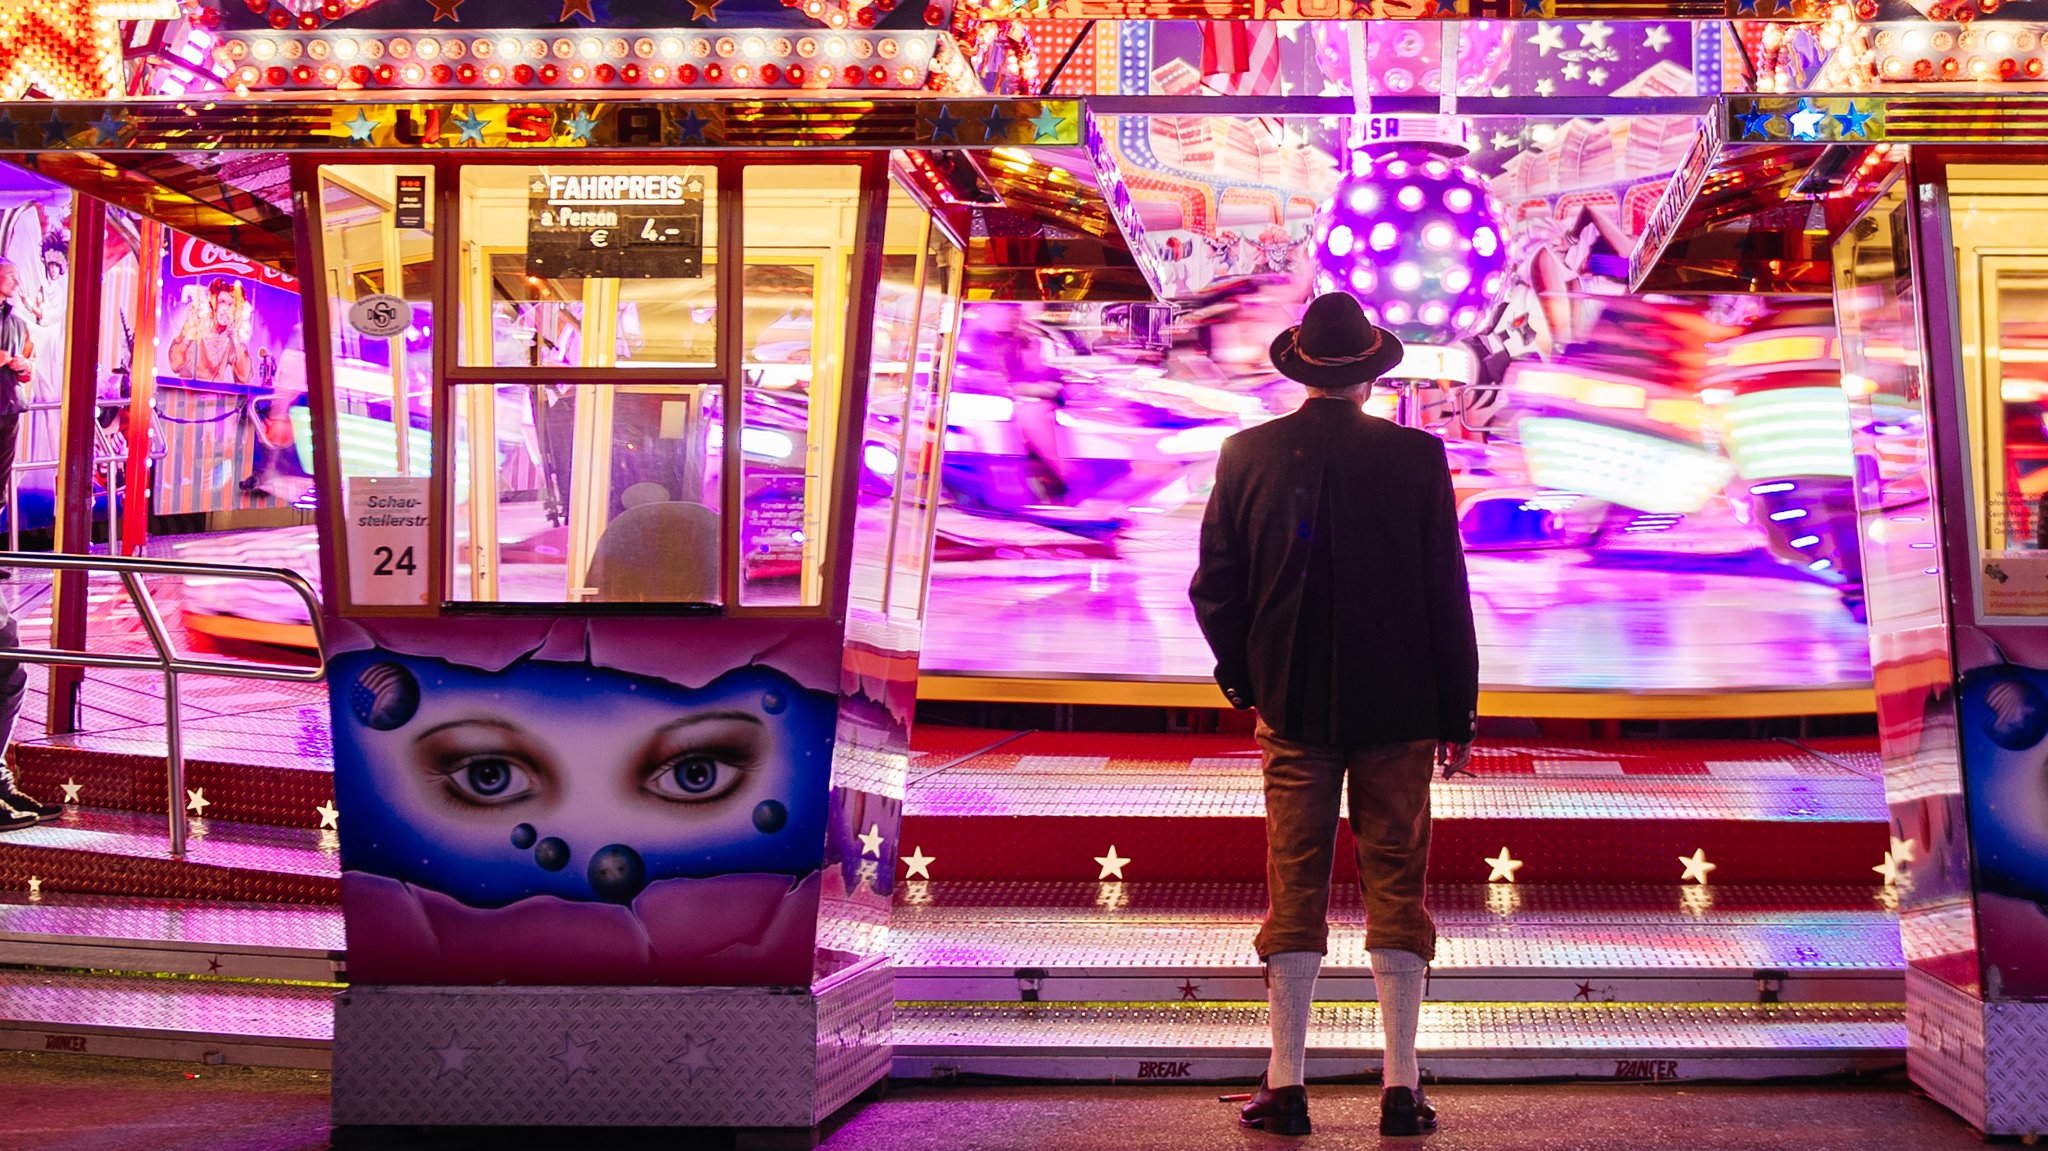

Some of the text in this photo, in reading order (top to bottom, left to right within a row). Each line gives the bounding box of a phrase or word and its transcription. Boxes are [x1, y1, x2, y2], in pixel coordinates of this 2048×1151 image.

[550, 175, 684, 199] FAHRPREIS
[559, 207, 619, 227] Person
[589, 229, 609, 248] €
[367, 495, 422, 508] Schau-
[357, 514, 432, 528] stellerstr.
[372, 545, 417, 576] 24
[1137, 1061, 1192, 1078] BREAK
[1614, 1060, 1681, 1078] DANCER
